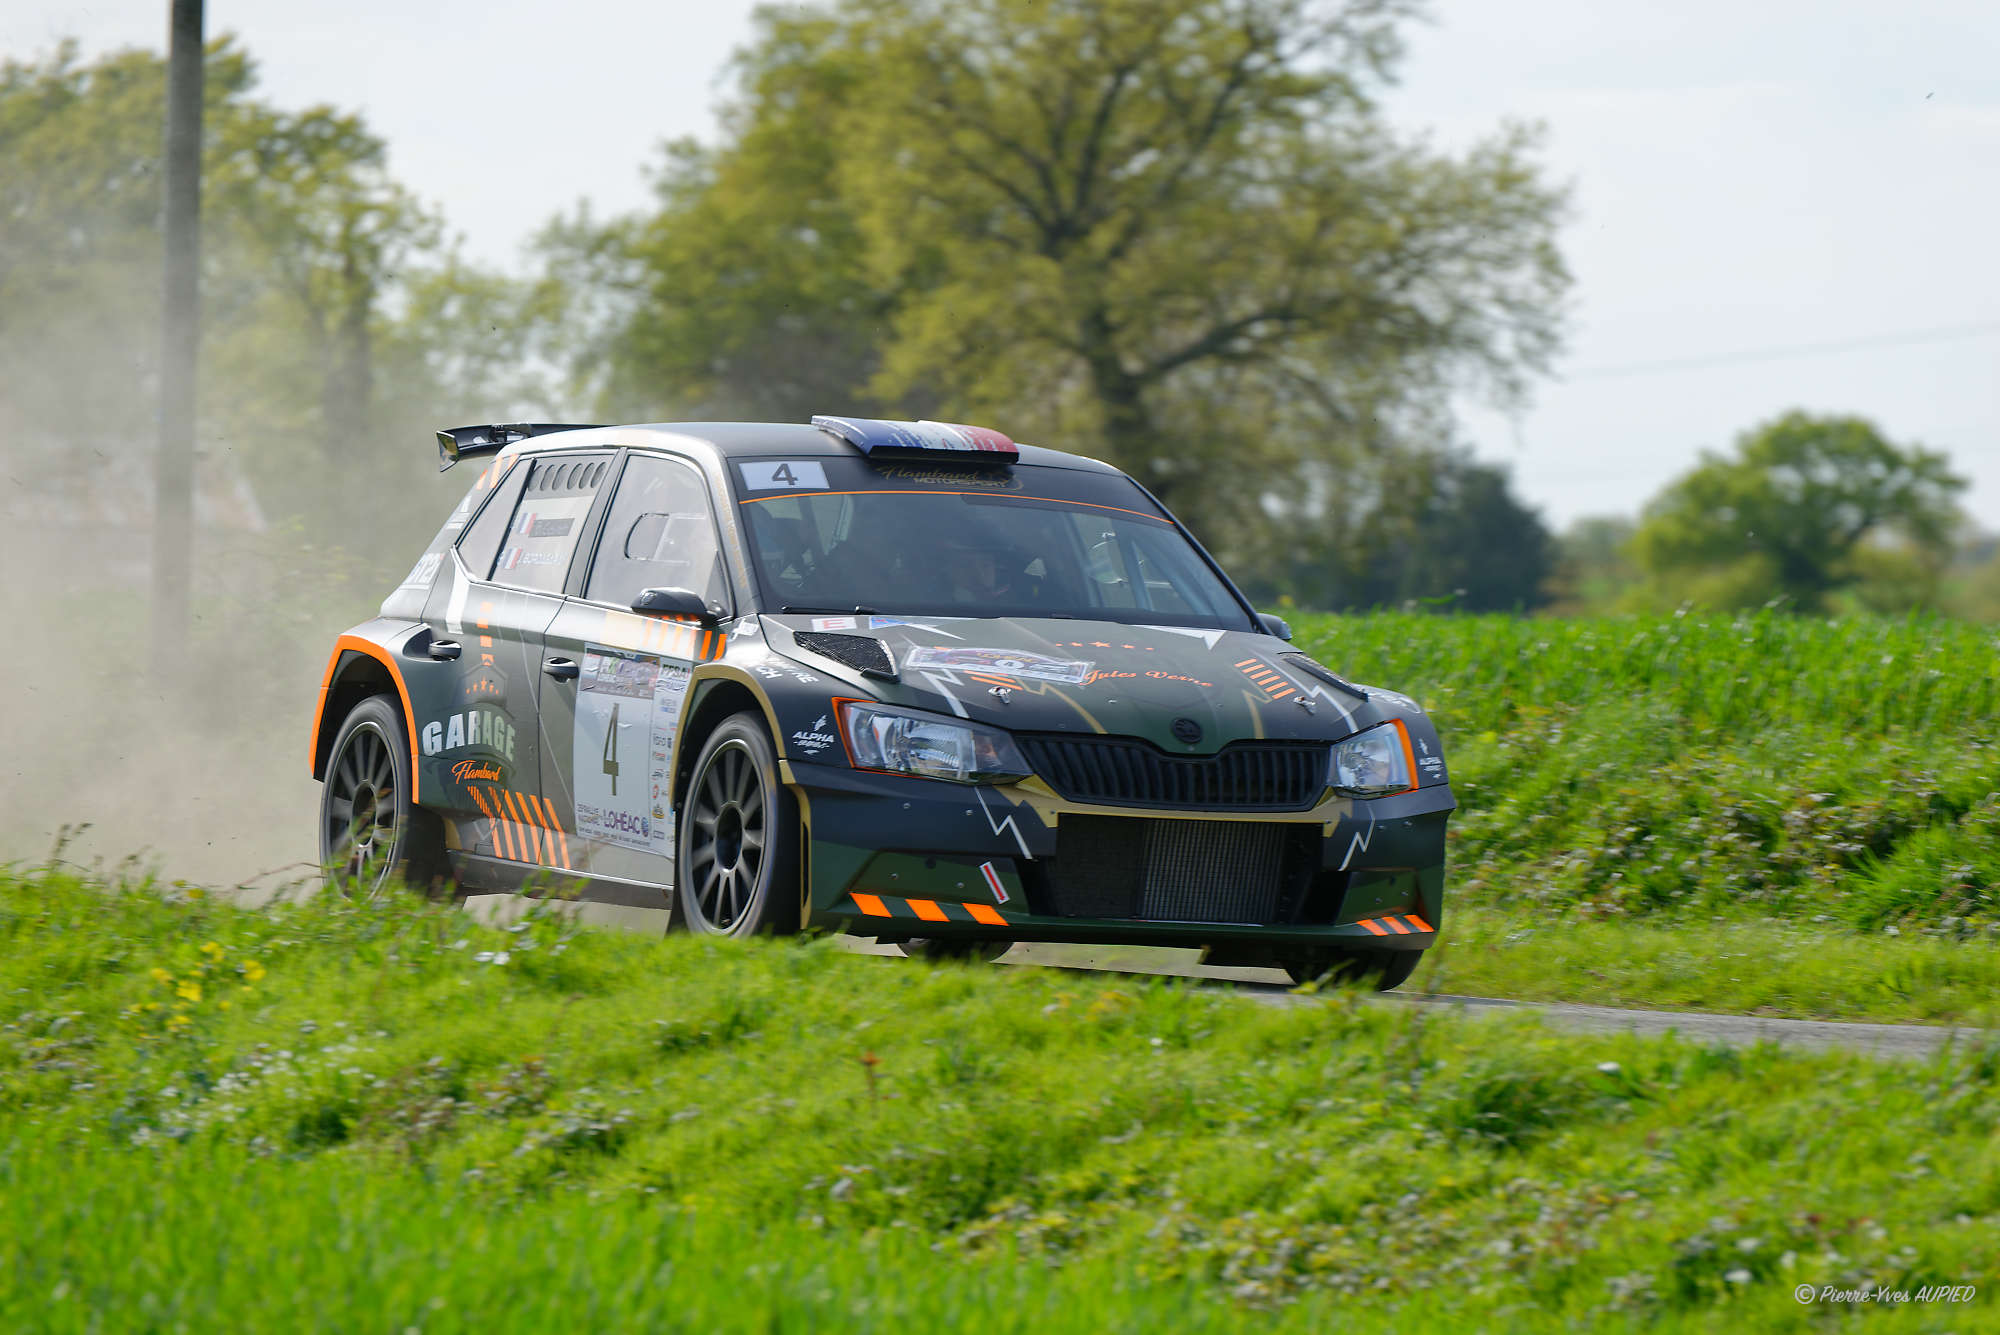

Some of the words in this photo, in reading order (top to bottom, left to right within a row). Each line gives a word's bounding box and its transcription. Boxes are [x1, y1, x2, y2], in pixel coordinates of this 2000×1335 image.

[771, 463, 798, 486] 4
[1079, 669, 1137, 686] Jules
[422, 710, 516, 762] GARAGE
[792, 731, 835, 743] ALPHA
[603, 703, 619, 796] 4
[603, 808, 641, 835] LOHÉAC
